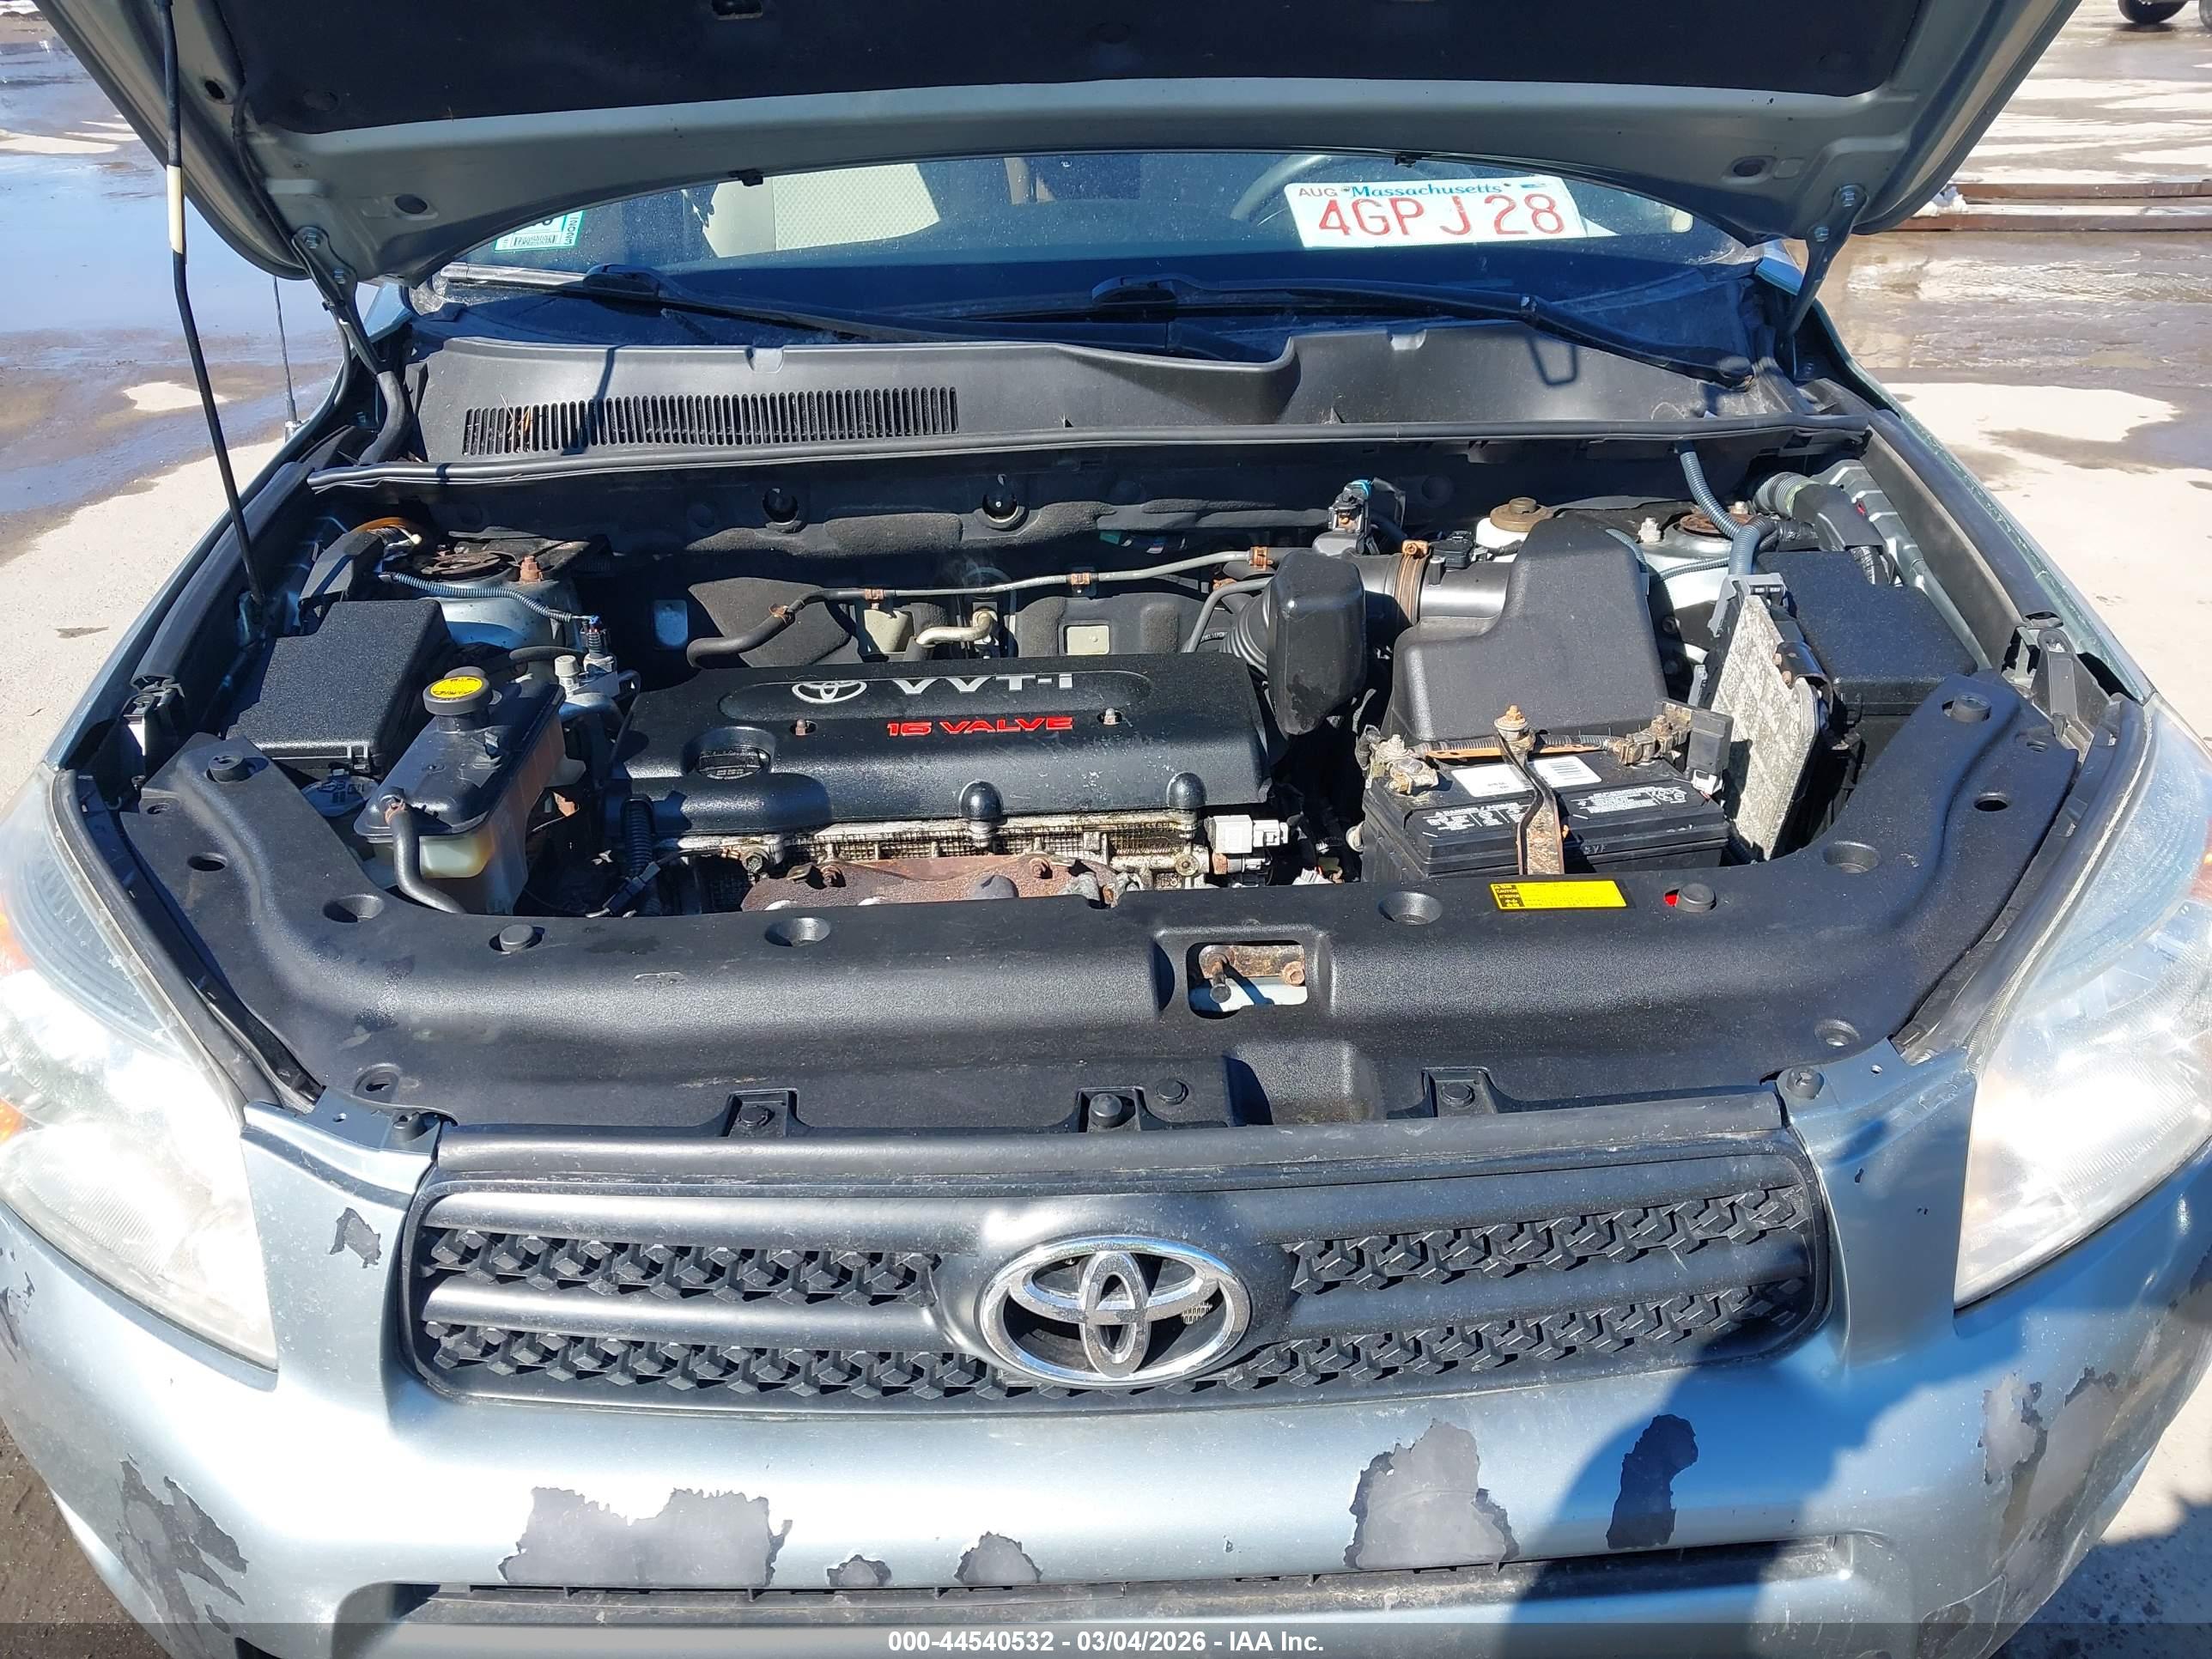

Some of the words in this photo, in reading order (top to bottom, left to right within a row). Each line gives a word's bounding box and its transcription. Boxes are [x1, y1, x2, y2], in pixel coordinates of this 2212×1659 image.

[1298, 187, 1339, 198] AUG
[1352, 183, 1503, 198] Massachusetts
[887, 721, 933, 737] 16
[939, 716, 1073, 734] VALVE
